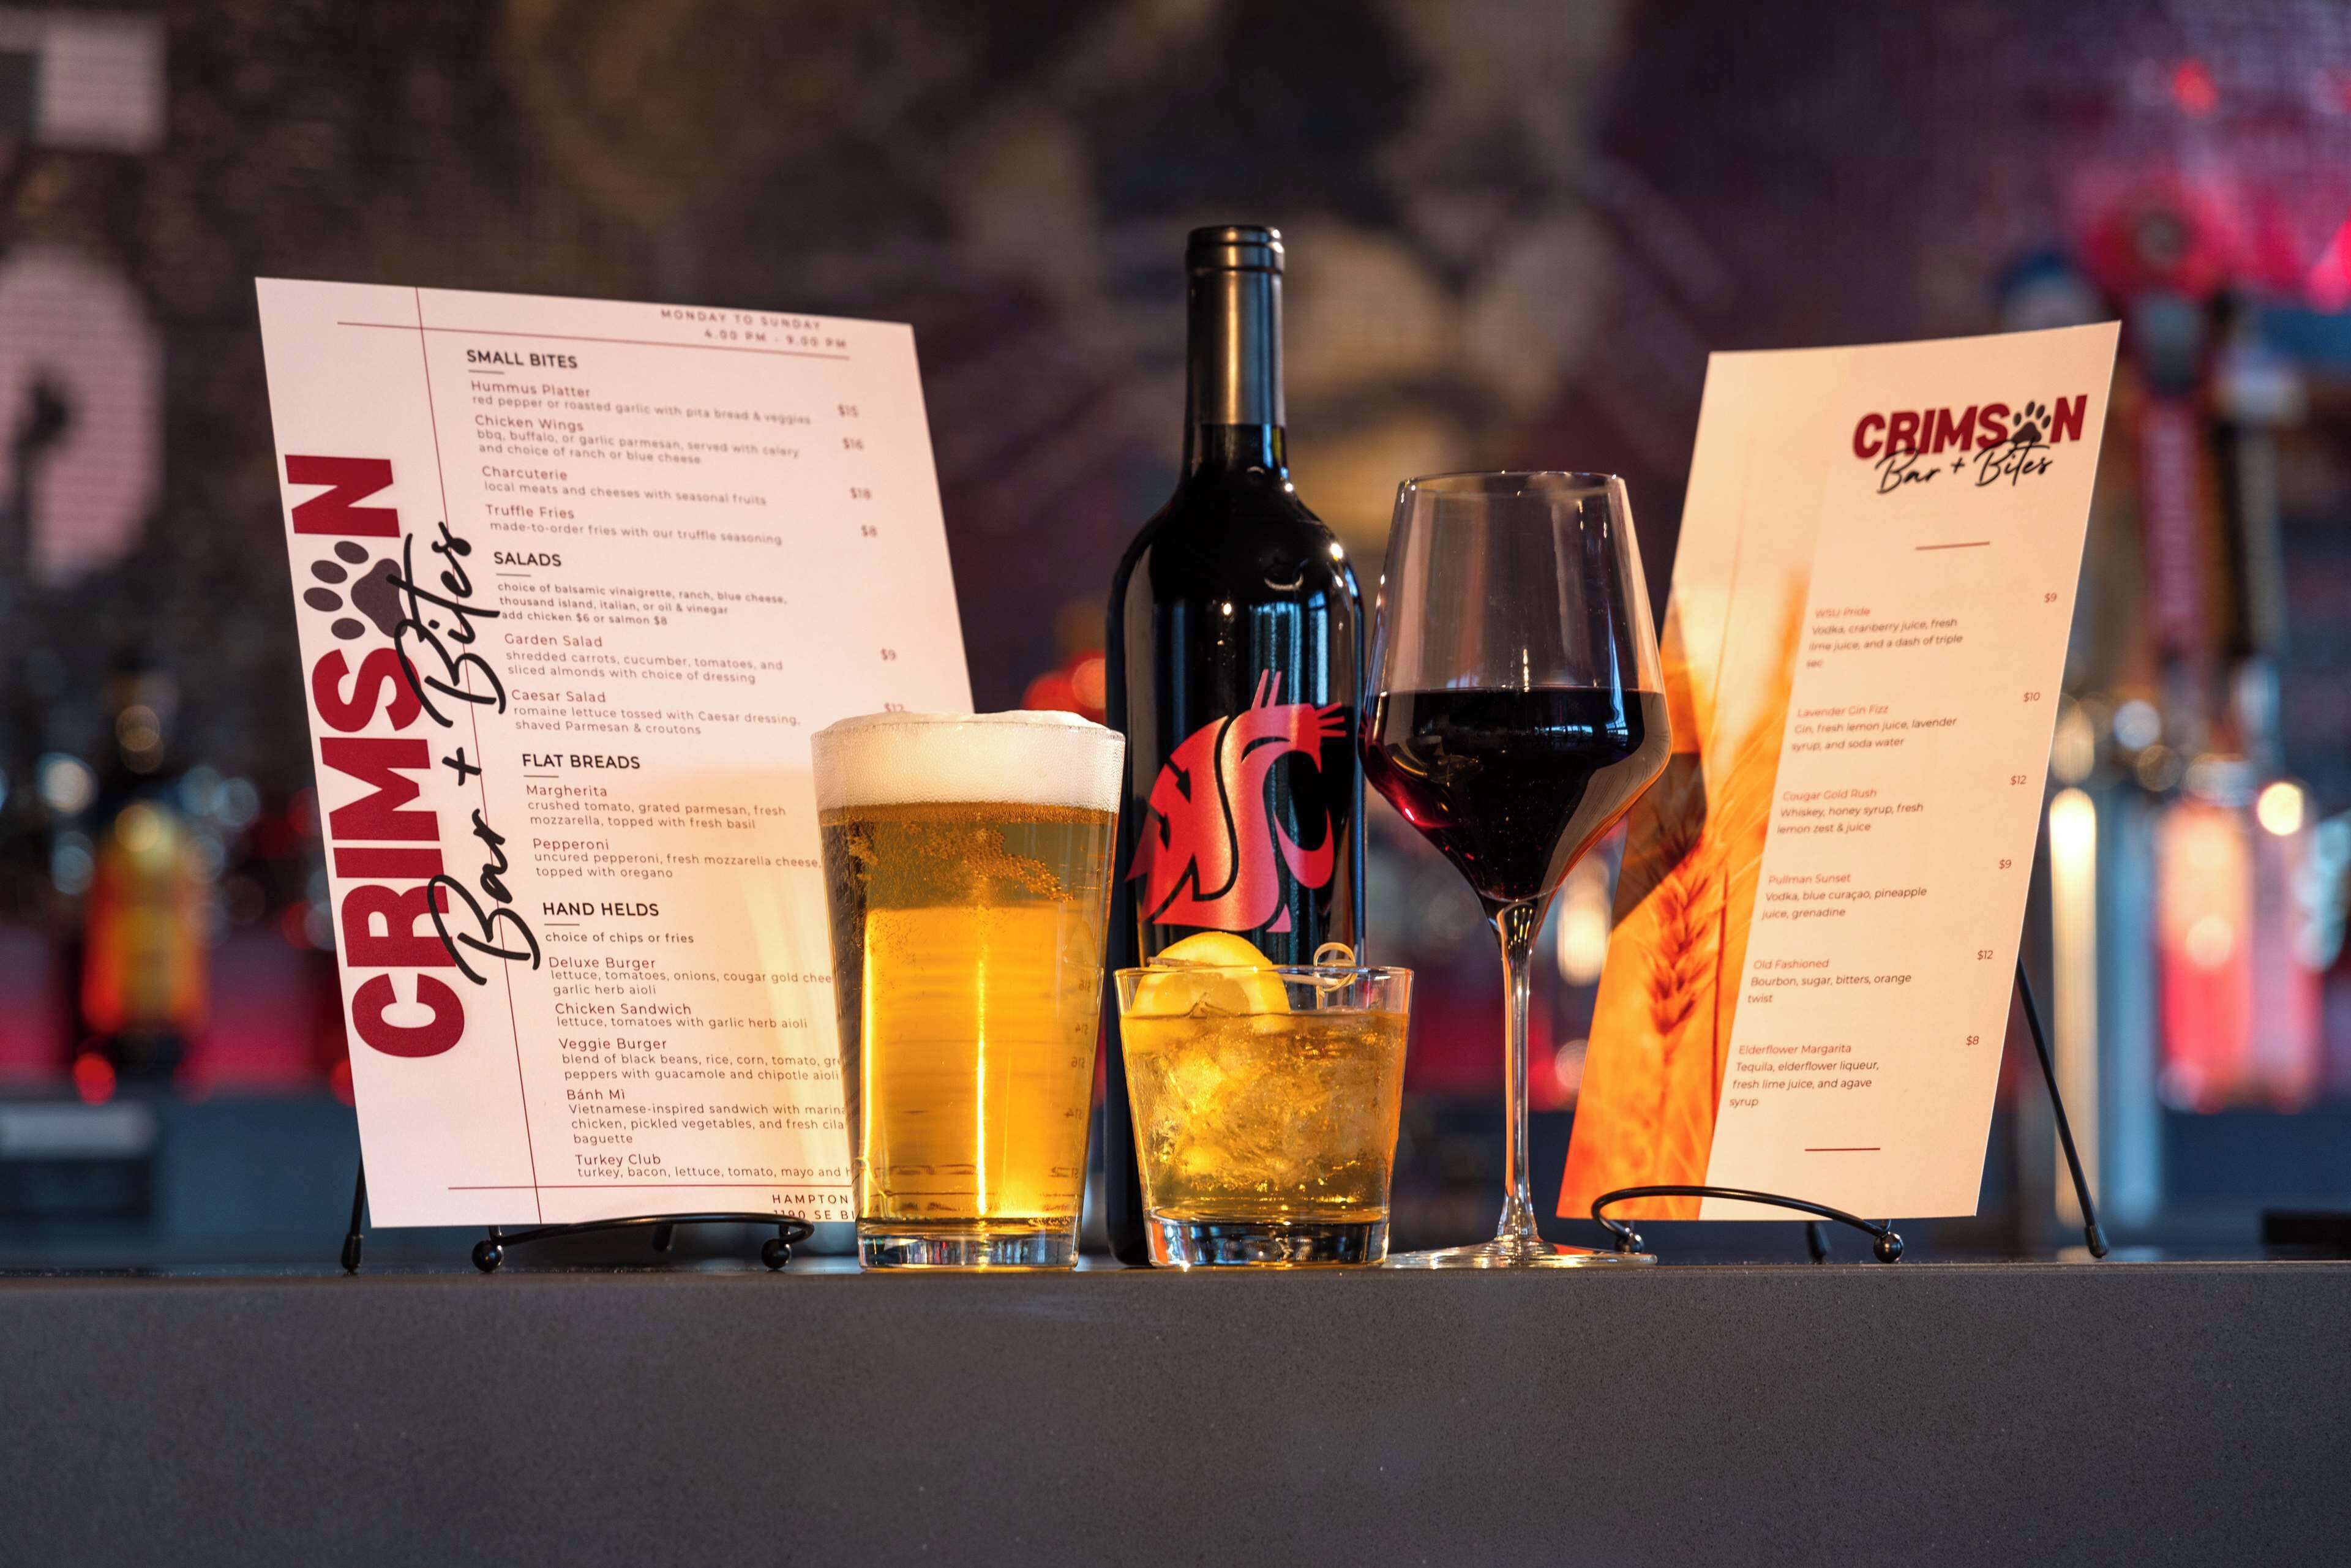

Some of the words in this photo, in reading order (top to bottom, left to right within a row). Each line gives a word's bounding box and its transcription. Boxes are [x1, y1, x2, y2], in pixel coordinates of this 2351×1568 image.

[659, 308, 726, 323] MONDAY
[733, 313, 754, 325] TO
[760, 315, 820, 331] SUNDAY
[744, 330, 767, 342] PM
[825, 337, 847, 349] PM
[466, 348, 525, 366] SMALL
[529, 353, 578, 369] BITES
[470, 380, 538, 396] Hummus
[541, 383, 590, 398] Platter
[474, 413, 534, 429] Chicken
[537, 418, 585, 435] Wings
[1853, 394, 2088, 460] CRIMSN
[843, 438, 864, 449] $16
[1874, 448, 1941, 494] Bar
[1973, 437, 2053, 487] Bites
[481, 465, 568, 482] Charcuterie
[484, 503, 534, 518] Truffle
[539, 506, 575, 520] Fries
[493, 551, 562, 568] SALADS
[2044, 593, 2057, 603] $9
[501, 609, 523, 620] add
[527, 610, 572, 622] chicken
[576, 612, 590, 623] $6
[608, 613, 650, 625] salmon
[653, 615, 668, 626] $8
[1814, 607, 1843, 619] WSU
[1842, 606, 1872, 618] Pride
[386, 521, 508, 728] Bites
[504, 632, 558, 646] Garden
[563, 634, 603, 648] Salad
[880, 648, 896, 660] $9
[511, 689, 561, 702] Caesar
[566, 690, 606, 703] Salad
[2023, 692, 2040, 702] $10
[1796, 707, 1847, 719] Lavender
[1868, 704, 1890, 715] Fizz
[284, 454, 465, 1059] CRIMSN
[522, 753, 564, 768] FLAT
[569, 754, 640, 770] BREADS
[2010, 775, 2027, 786] $12
[526, 784, 607, 799] Margherita
[1782, 790, 1823, 803] Cougar
[1821, 789, 1850, 801] Gold
[1850, 787, 1878, 799] Rush
[527, 800, 580, 811] crushed
[583, 801, 634, 814] tomato,
[638, 803, 680, 815] grated
[684, 805, 751, 819] parmesan,
[754, 804, 786, 816] fresh
[533, 838, 609, 854] Pepperoni
[1998, 859, 2011, 869] $9
[1768, 874, 1813, 886] Pullman
[1814, 873, 1852, 884] Sunset
[426, 809, 541, 986] Bar
[542, 902, 595, 916] HAND
[601, 902, 659, 917] HELDS
[545, 931, 588, 942] choice
[592, 931, 605, 942] of
[609, 932, 643, 945] chips
[648, 934, 661, 943] or
[664, 932, 694, 943] fries
[1977, 950, 1993, 961] $12
[549, 956, 599, 969] Deluxe
[605, 956, 656, 972] Burger
[1753, 959, 1774, 970] Old
[1774, 958, 1830, 970] Fashioned
[550, 969, 601, 981] lettuce,
[604, 969, 670, 982] tomatoes,
[673, 970, 719, 983] onions,
[723, 973, 766, 985] cougar
[770, 972, 799, 985] gold
[803, 972, 832, 984] chee
[1750, 976, 1799, 988] Bourbon,
[1801, 977, 1833, 988] sugar,
[1835, 974, 1872, 985] bitters,
[1873, 974, 1912, 986] orange
[553, 984, 591, 997] garlic
[594, 984, 624, 995] herb
[629, 984, 656, 995] aioli
[1747, 994, 1774, 1003] twist
[555, 1002, 615, 1015] Chicken
[620, 1002, 691, 1015] Sandwich
[557, 1015, 607, 1029] lettuce,
[610, 1017, 672, 1027] tomatoes
[675, 1016, 704, 1027] with
[708, 1017, 744, 1030] garlic
[748, 1017, 777, 1029] herb
[780, 1018, 808, 1029] aioli
[558, 1037, 611, 1052] Veggie
[617, 1037, 667, 1052] Burger
[1966, 1035, 1979, 1046] $8
[1738, 1044, 1799, 1056] Elderflower
[1801, 1043, 1852, 1056] Margarita
[561, 1053, 599, 1064] blend
[604, 1052, 617, 1064] of
[621, 1052, 656, 1064] black
[660, 1053, 702, 1066] beans,
[705, 1053, 733, 1067] rice,
[737, 1056, 768, 1067] corn,
[771, 1055, 820, 1067] tomato,
[1735, 1061, 1775, 1073] Tequila,
[1777, 1060, 1838, 1072] elderflower
[1839, 1060, 1879, 1073] liqueur,
[564, 1070, 618, 1082] peppers
[621, 1068, 650, 1079] with
[653, 1068, 726, 1082] guacamole
[730, 1068, 754, 1080] and
[757, 1069, 809, 1083] chipotle
[812, 1070, 839, 1080] aioli
[1732, 1079, 1760, 1090] fresh
[1761, 1079, 1787, 1089] lime
[1787, 1079, 1815, 1092] juice,
[1817, 1078, 1839, 1089] and
[1840, 1079, 1873, 1090] agave
[566, 1088, 603, 1100] Bánh
[568, 1103, 705, 1116] Vietnamese-inspired
[708, 1103, 769, 1114] sandwich
[772, 1103, 800, 1115] with
[804, 1105, 845, 1115] marina
[1728, 1098, 1760, 1109] syrup
[571, 1117, 626, 1131] chicken,
[631, 1117, 678, 1132] pickled
[681, 1117, 755, 1131] vegetables,
[759, 1118, 782, 1130] and
[786, 1117, 819, 1130] fresh
[822, 1119, 844, 1130] cila
[573, 1133, 633, 1147] baguette
[574, 1153, 623, 1168] Turkey
[628, 1153, 661, 1165] Club
[577, 1165, 623, 1180] turkey,
[627, 1166, 671, 1179] bacon,
[675, 1165, 724, 1178] lettuce,
[727, 1166, 777, 1179] tomato,
[781, 1168, 814, 1179] mayo
[818, 1166, 841, 1177] and
[772, 1195, 848, 1204] HAMPTON
[814, 1210, 831, 1220] SE
